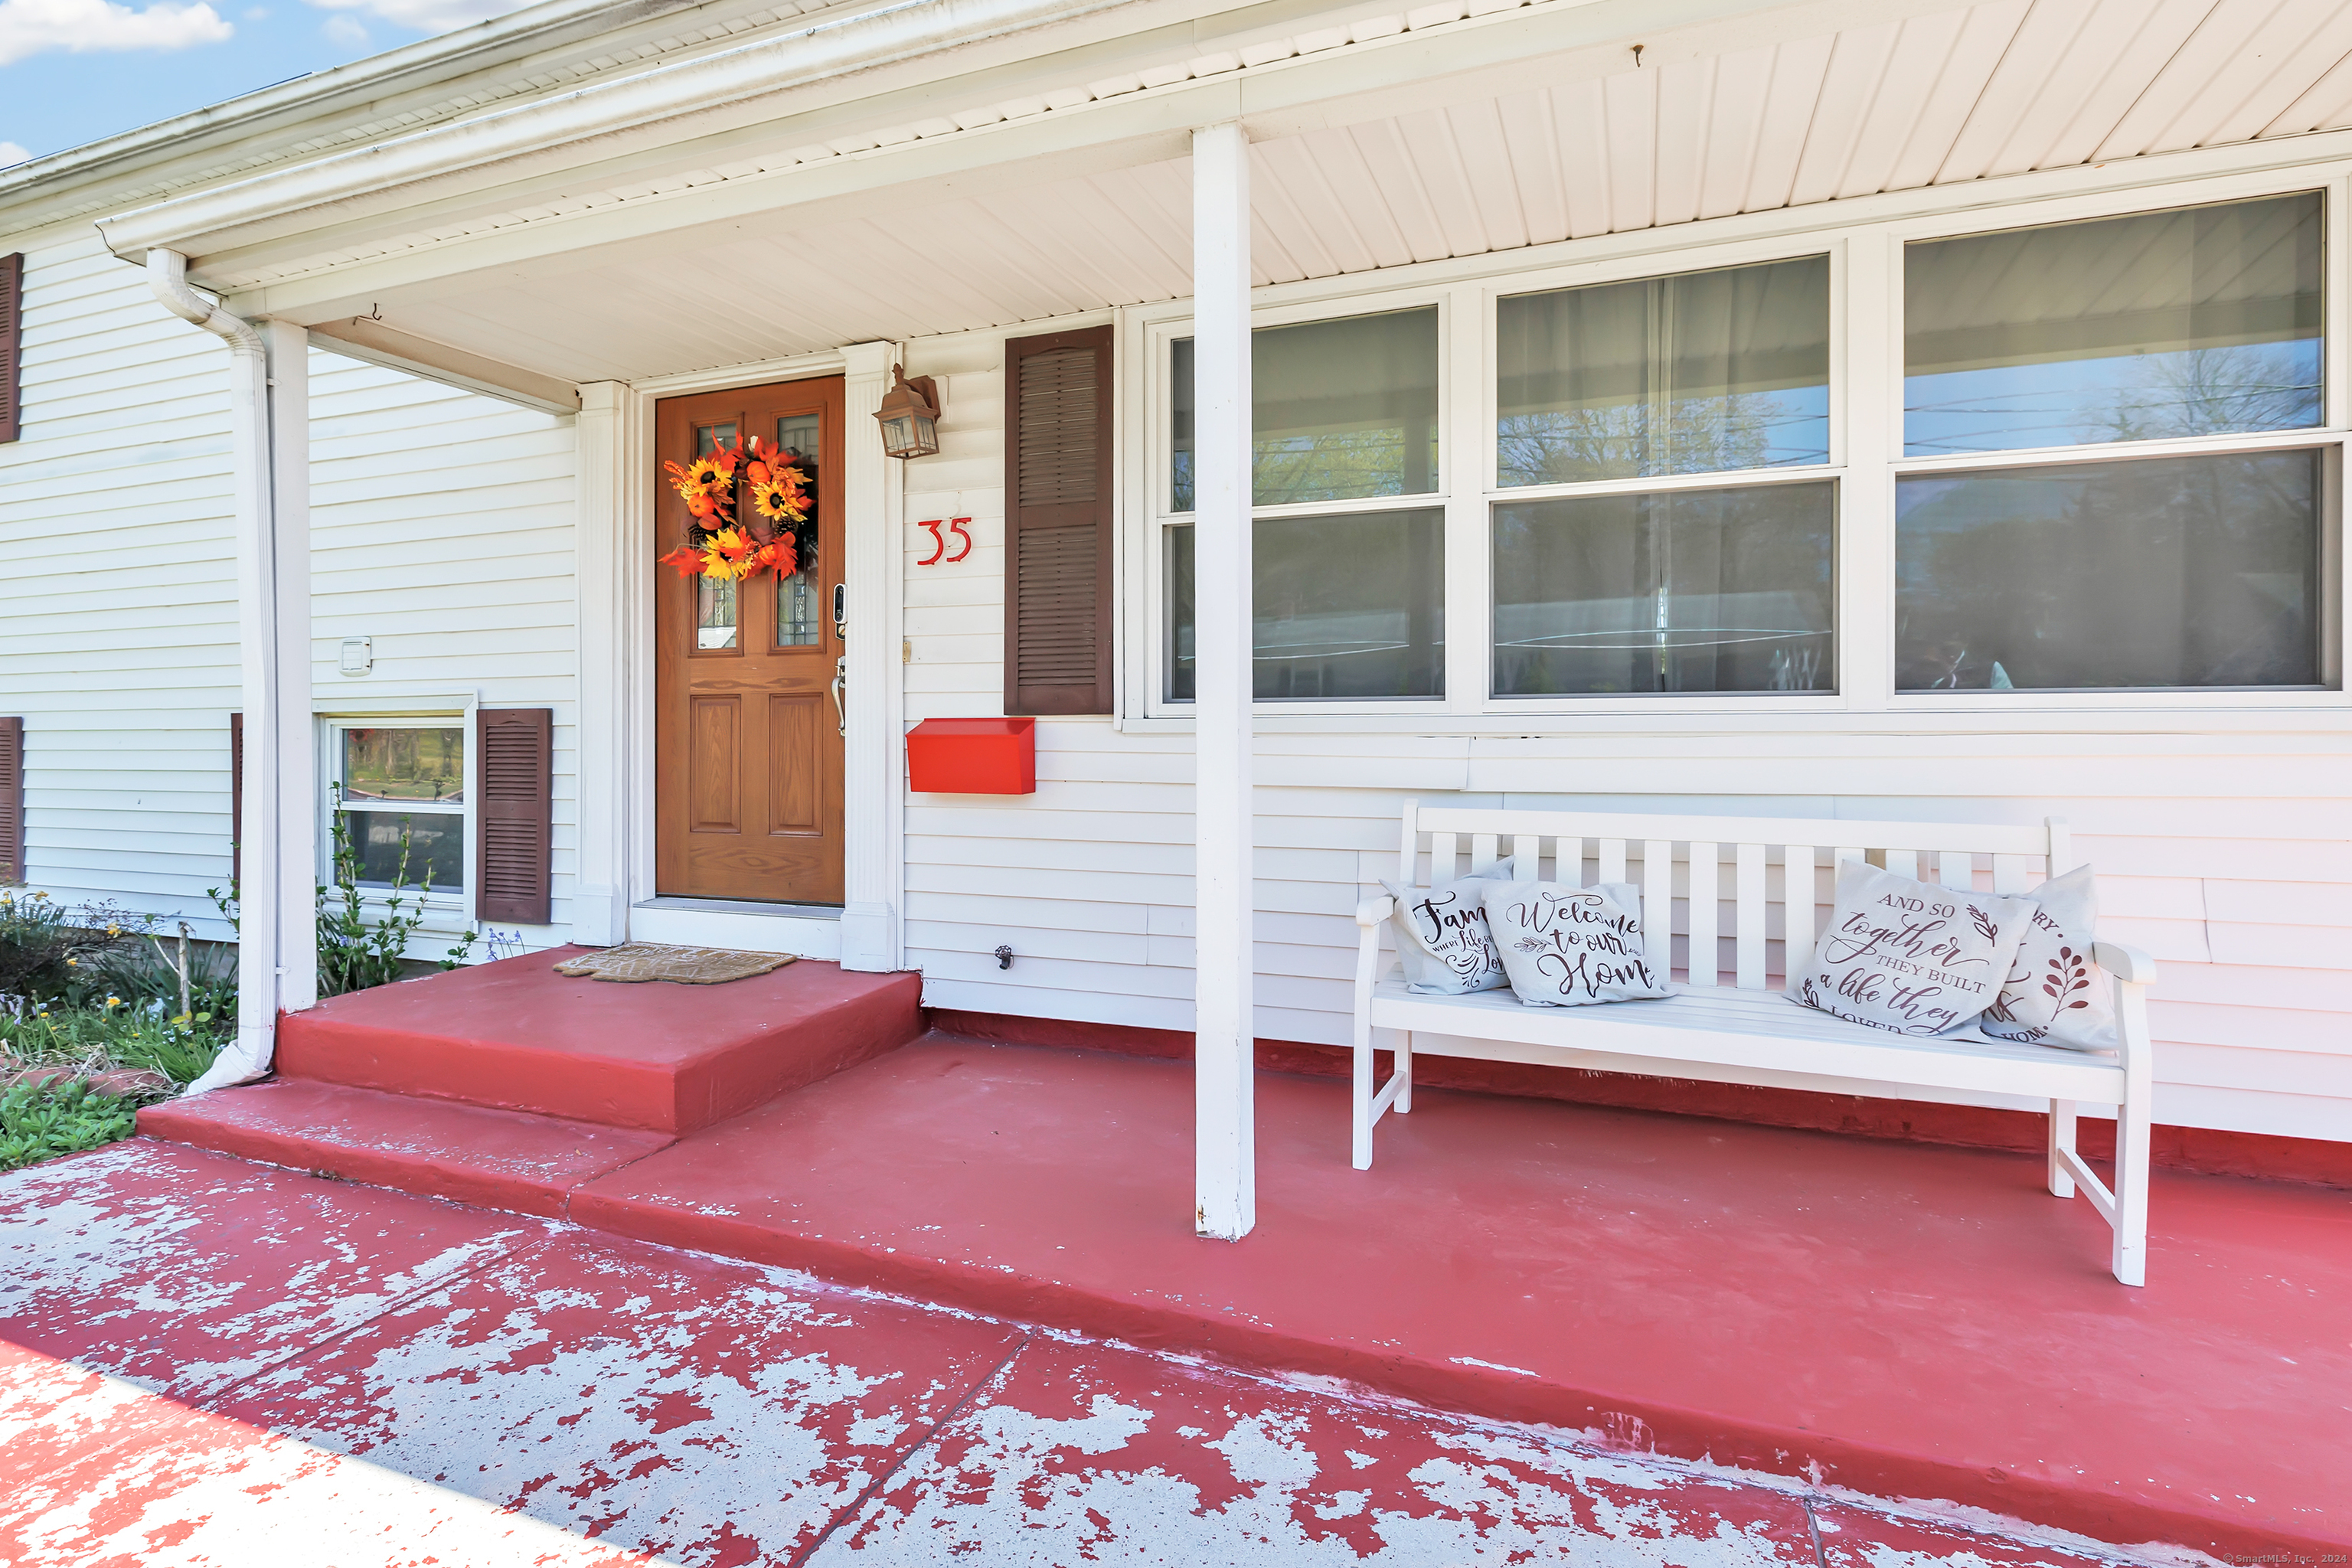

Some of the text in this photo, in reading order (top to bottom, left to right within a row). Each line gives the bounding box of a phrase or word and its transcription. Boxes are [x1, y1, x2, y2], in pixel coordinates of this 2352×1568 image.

[917, 517, 972, 566] 35
[1505, 891, 1640, 938] Welcome
[1877, 893, 1955, 919] AND SO
[1432, 939, 1459, 952] WHERE
[1451, 928, 1485, 952] Life
[1549, 929, 1627, 956] to our
[1824, 911, 1990, 965] together
[1875, 955, 1986, 994] THEY BUILT
[1819, 973, 1833, 988] a
[1838, 968, 1886, 1004] life
[1886, 977, 1959, 1037] they
